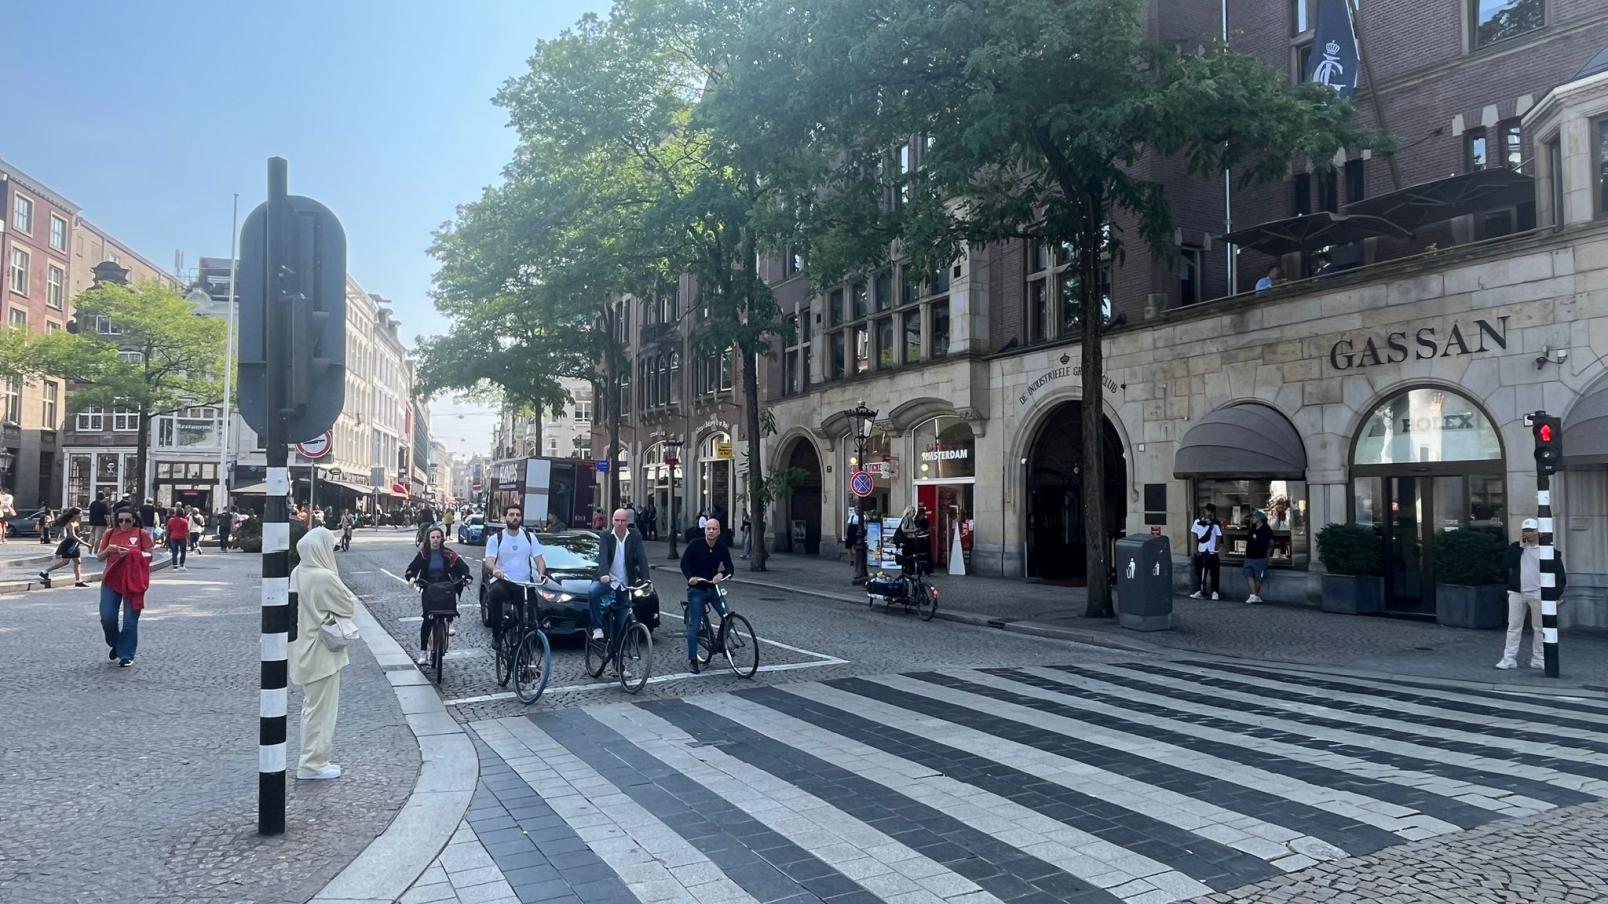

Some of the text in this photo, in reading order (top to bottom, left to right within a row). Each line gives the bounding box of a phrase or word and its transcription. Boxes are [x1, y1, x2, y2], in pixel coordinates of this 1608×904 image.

[1330, 315, 1512, 371] GASSAN
[1019, 394, 1028, 405] DE
[921, 448, 968, 461] AMSTERDAM
